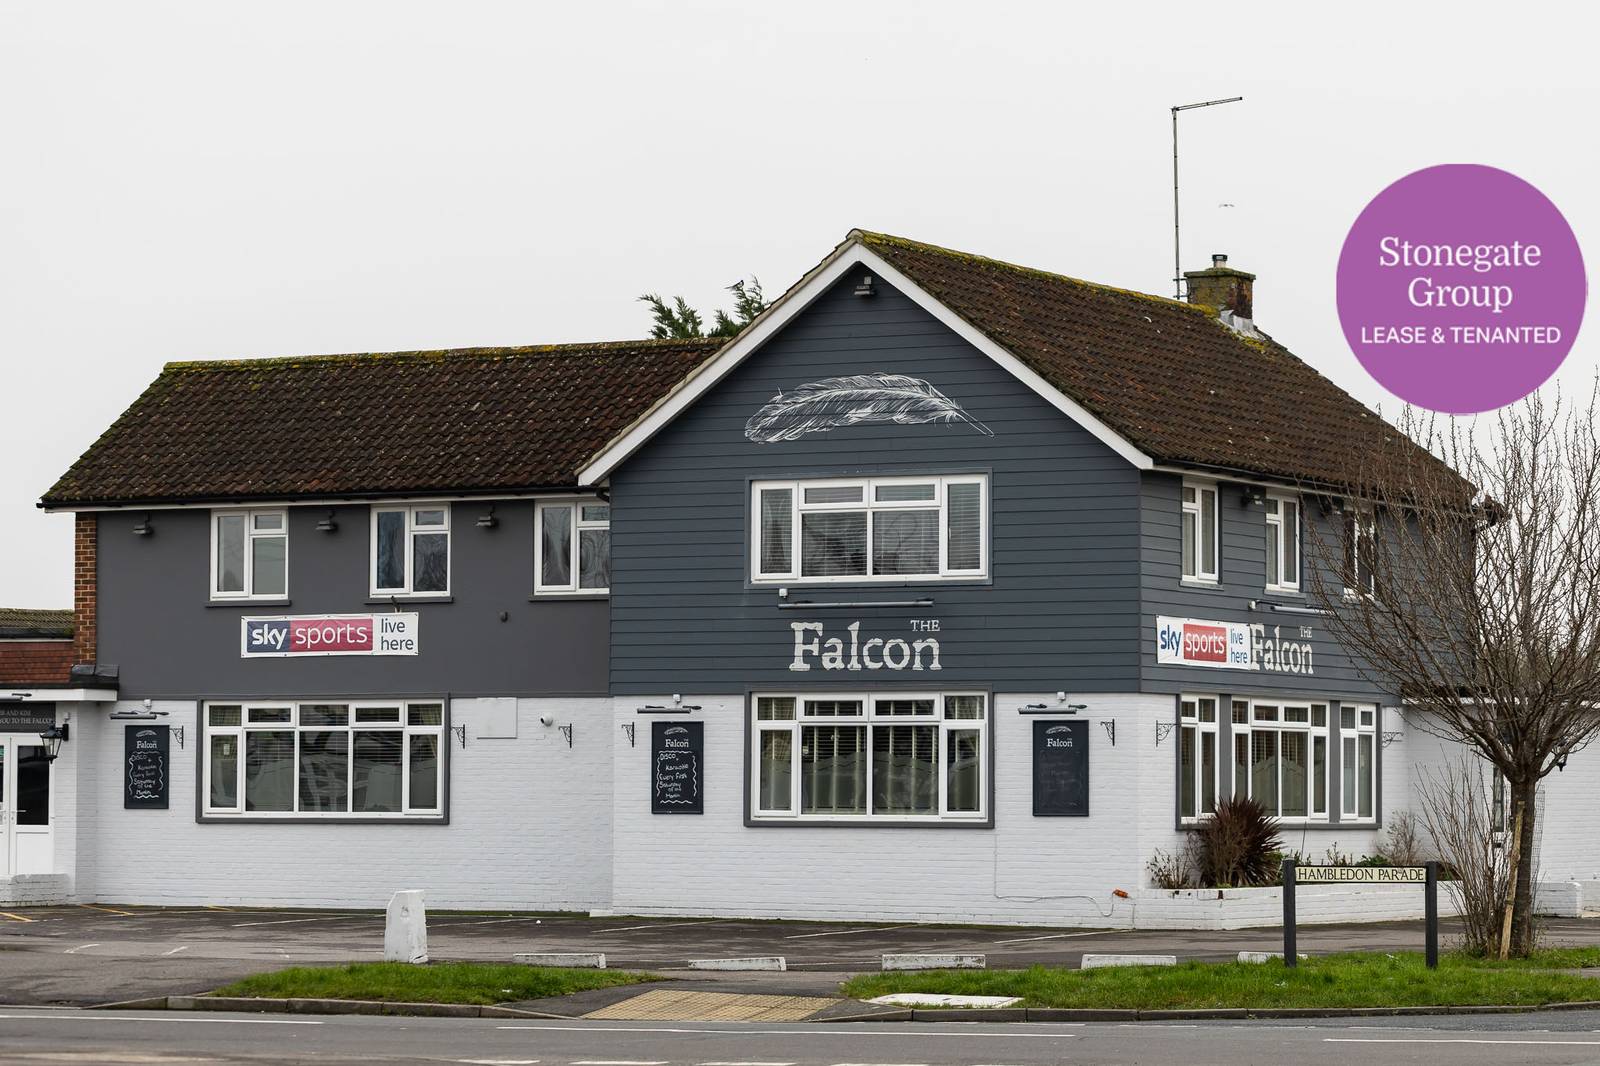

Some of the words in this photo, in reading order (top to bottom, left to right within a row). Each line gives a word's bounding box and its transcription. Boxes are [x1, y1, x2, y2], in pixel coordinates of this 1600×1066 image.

[380, 618, 406, 633] live
[910, 619, 941, 632] THE
[1299, 625, 1313, 638] THE
[251, 623, 288, 650] sky
[295, 623, 368, 649] sports
[380, 636, 414, 651] here
[1160, 624, 1181, 656] sky
[1185, 631, 1225, 656] sports
[1230, 628, 1244, 645] live
[788, 621, 943, 672] Falcon
[1250, 622, 1314, 675] Falcon
[1230, 649, 1248, 664] here
[136, 741, 158, 749] Falcon
[665, 739, 689, 748] Falcon
[1047, 738, 1073, 747] Falcon
[1298, 868, 1374, 881] HAMBLEDON
[1378, 868, 1424, 881] PARADE
